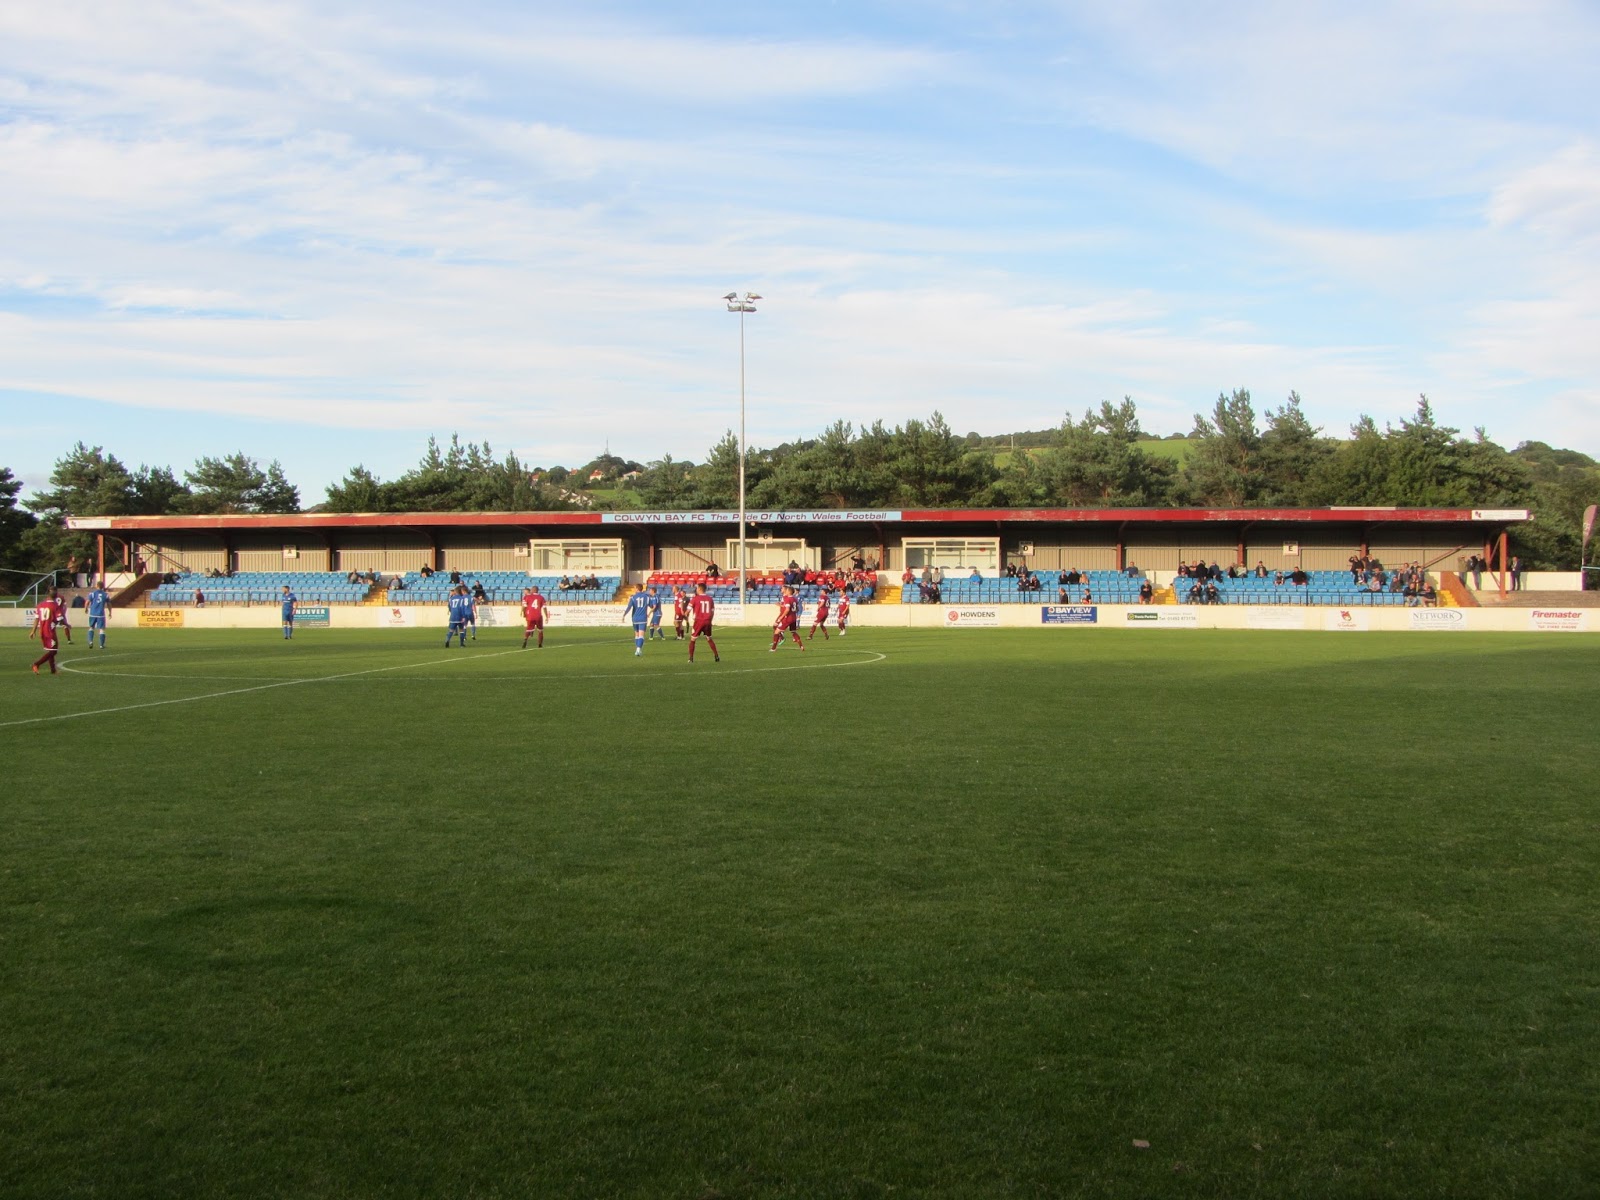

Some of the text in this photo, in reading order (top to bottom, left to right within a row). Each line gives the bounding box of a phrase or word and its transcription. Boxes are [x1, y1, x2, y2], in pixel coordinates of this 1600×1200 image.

[846, 512, 887, 520] Football
[97, 593, 104, 603] 5
[451, 598, 460, 608] 17
[636, 597, 645, 608] 11
[531, 599, 539, 609] 4
[700, 601, 710, 614] 11
[40, 607, 51, 621] 10
[566, 607, 599, 615] bebbington
[1532, 610, 1582, 618] Firemaster
